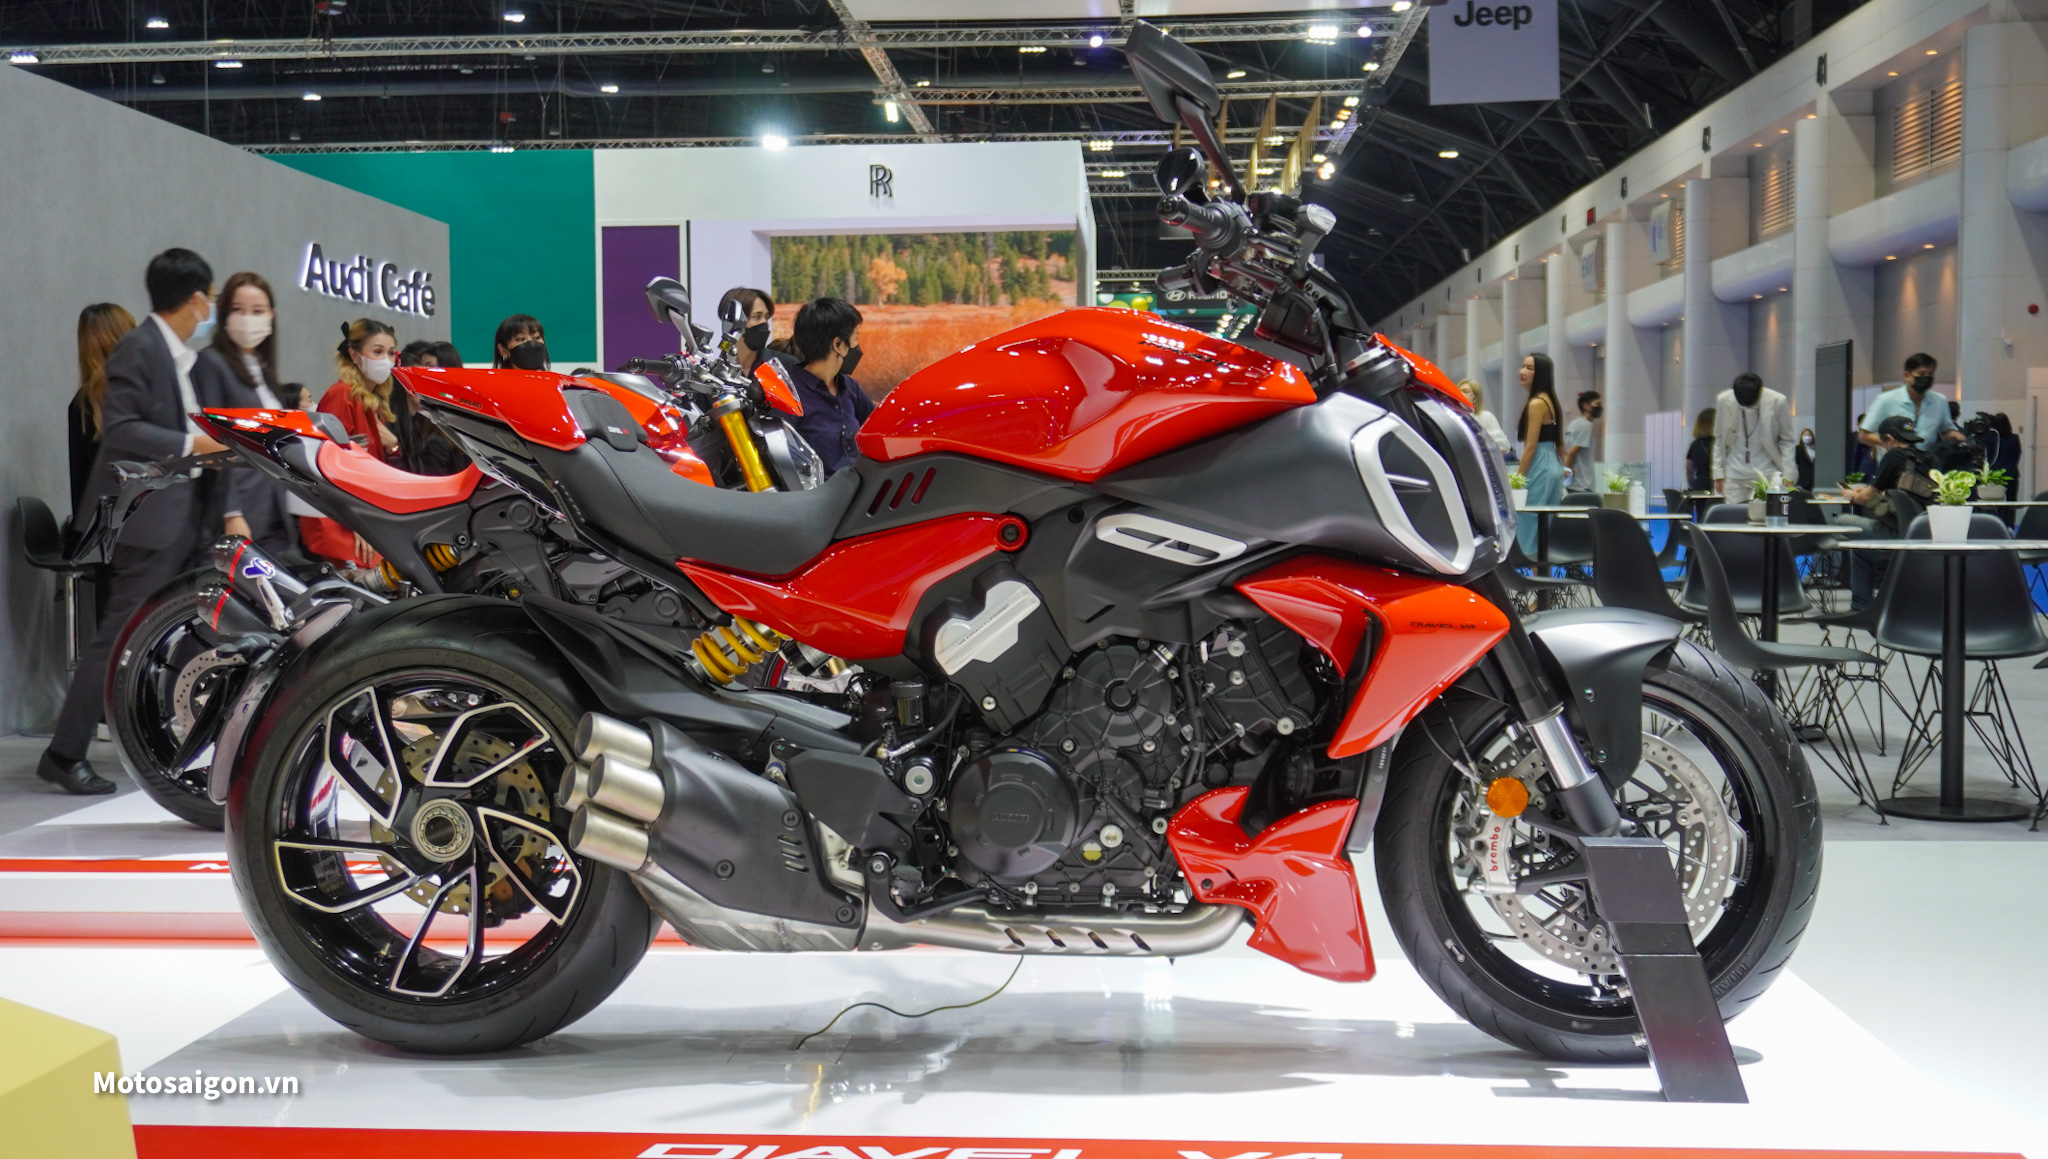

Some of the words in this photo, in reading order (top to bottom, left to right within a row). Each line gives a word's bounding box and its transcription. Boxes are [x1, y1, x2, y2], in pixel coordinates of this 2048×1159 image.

[1454, 0, 1533, 31] Jeep
[302, 242, 374, 303] Audi
[380, 261, 436, 317] Café
[1410, 621, 1458, 630] DIAVEL
[1489, 826, 1502, 872] brembo
